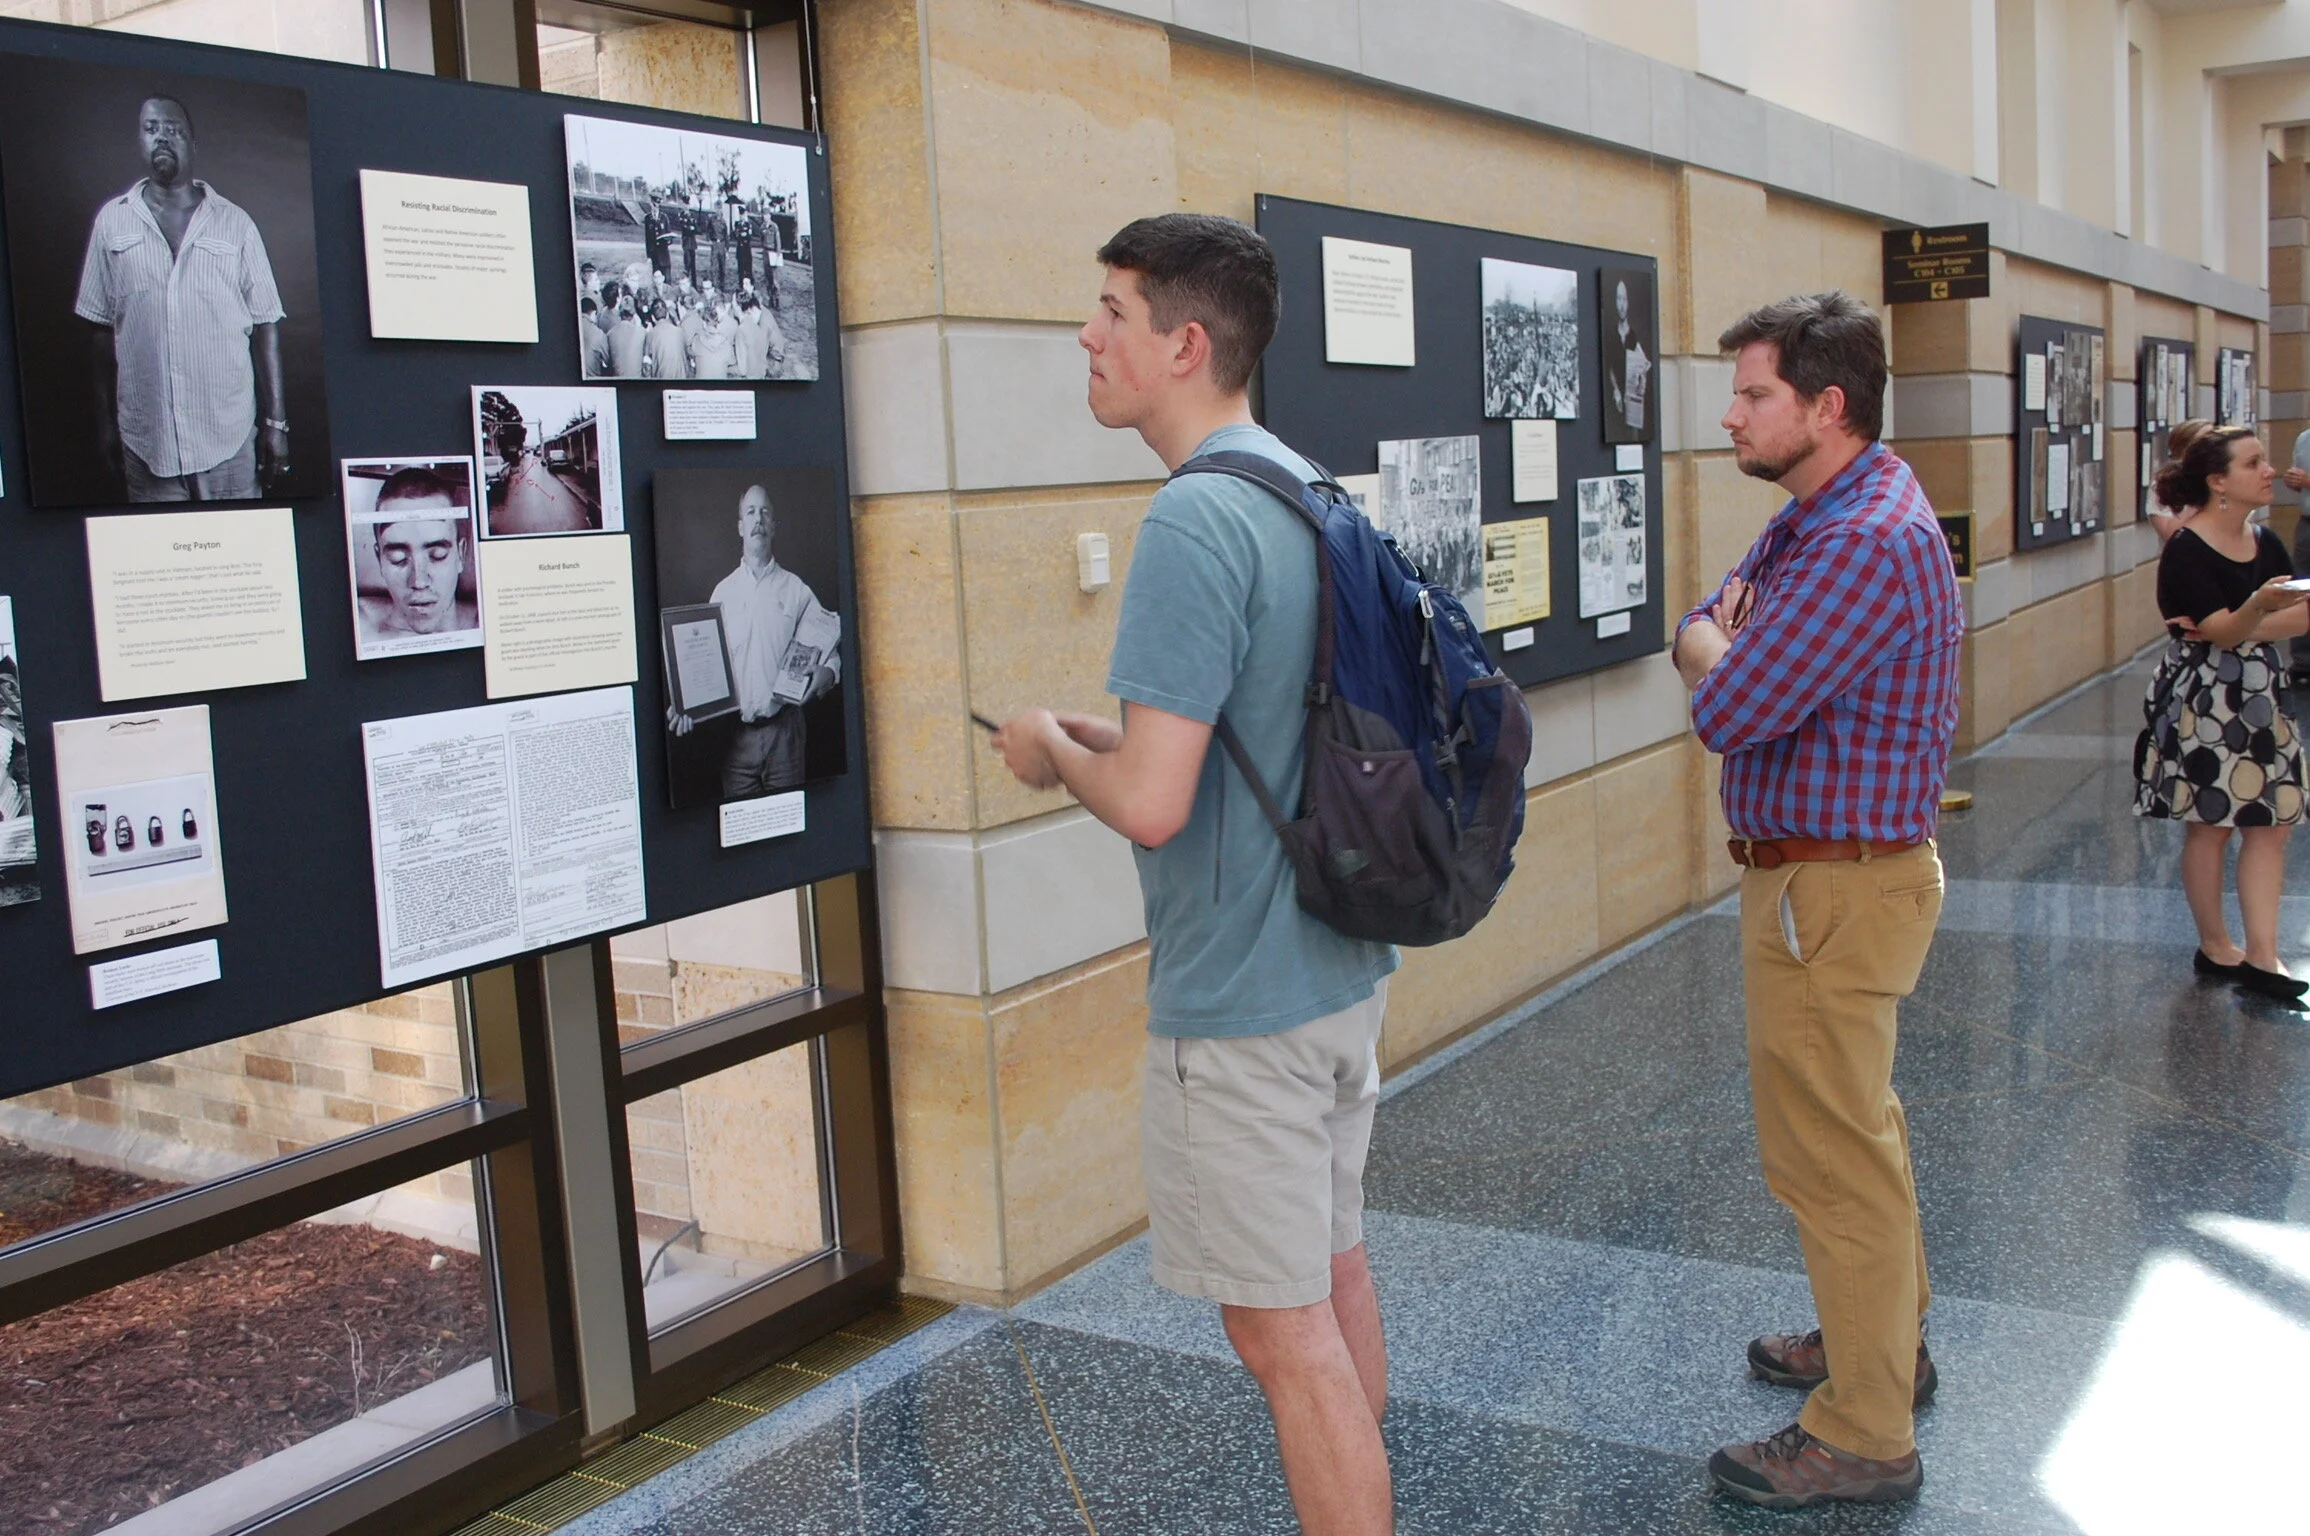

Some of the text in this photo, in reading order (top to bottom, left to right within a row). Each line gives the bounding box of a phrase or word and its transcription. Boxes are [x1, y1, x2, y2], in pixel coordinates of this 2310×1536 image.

[401, 200, 497, 215] Resisting Racial Discrimination
[173, 541, 221, 552] Greg Payton
